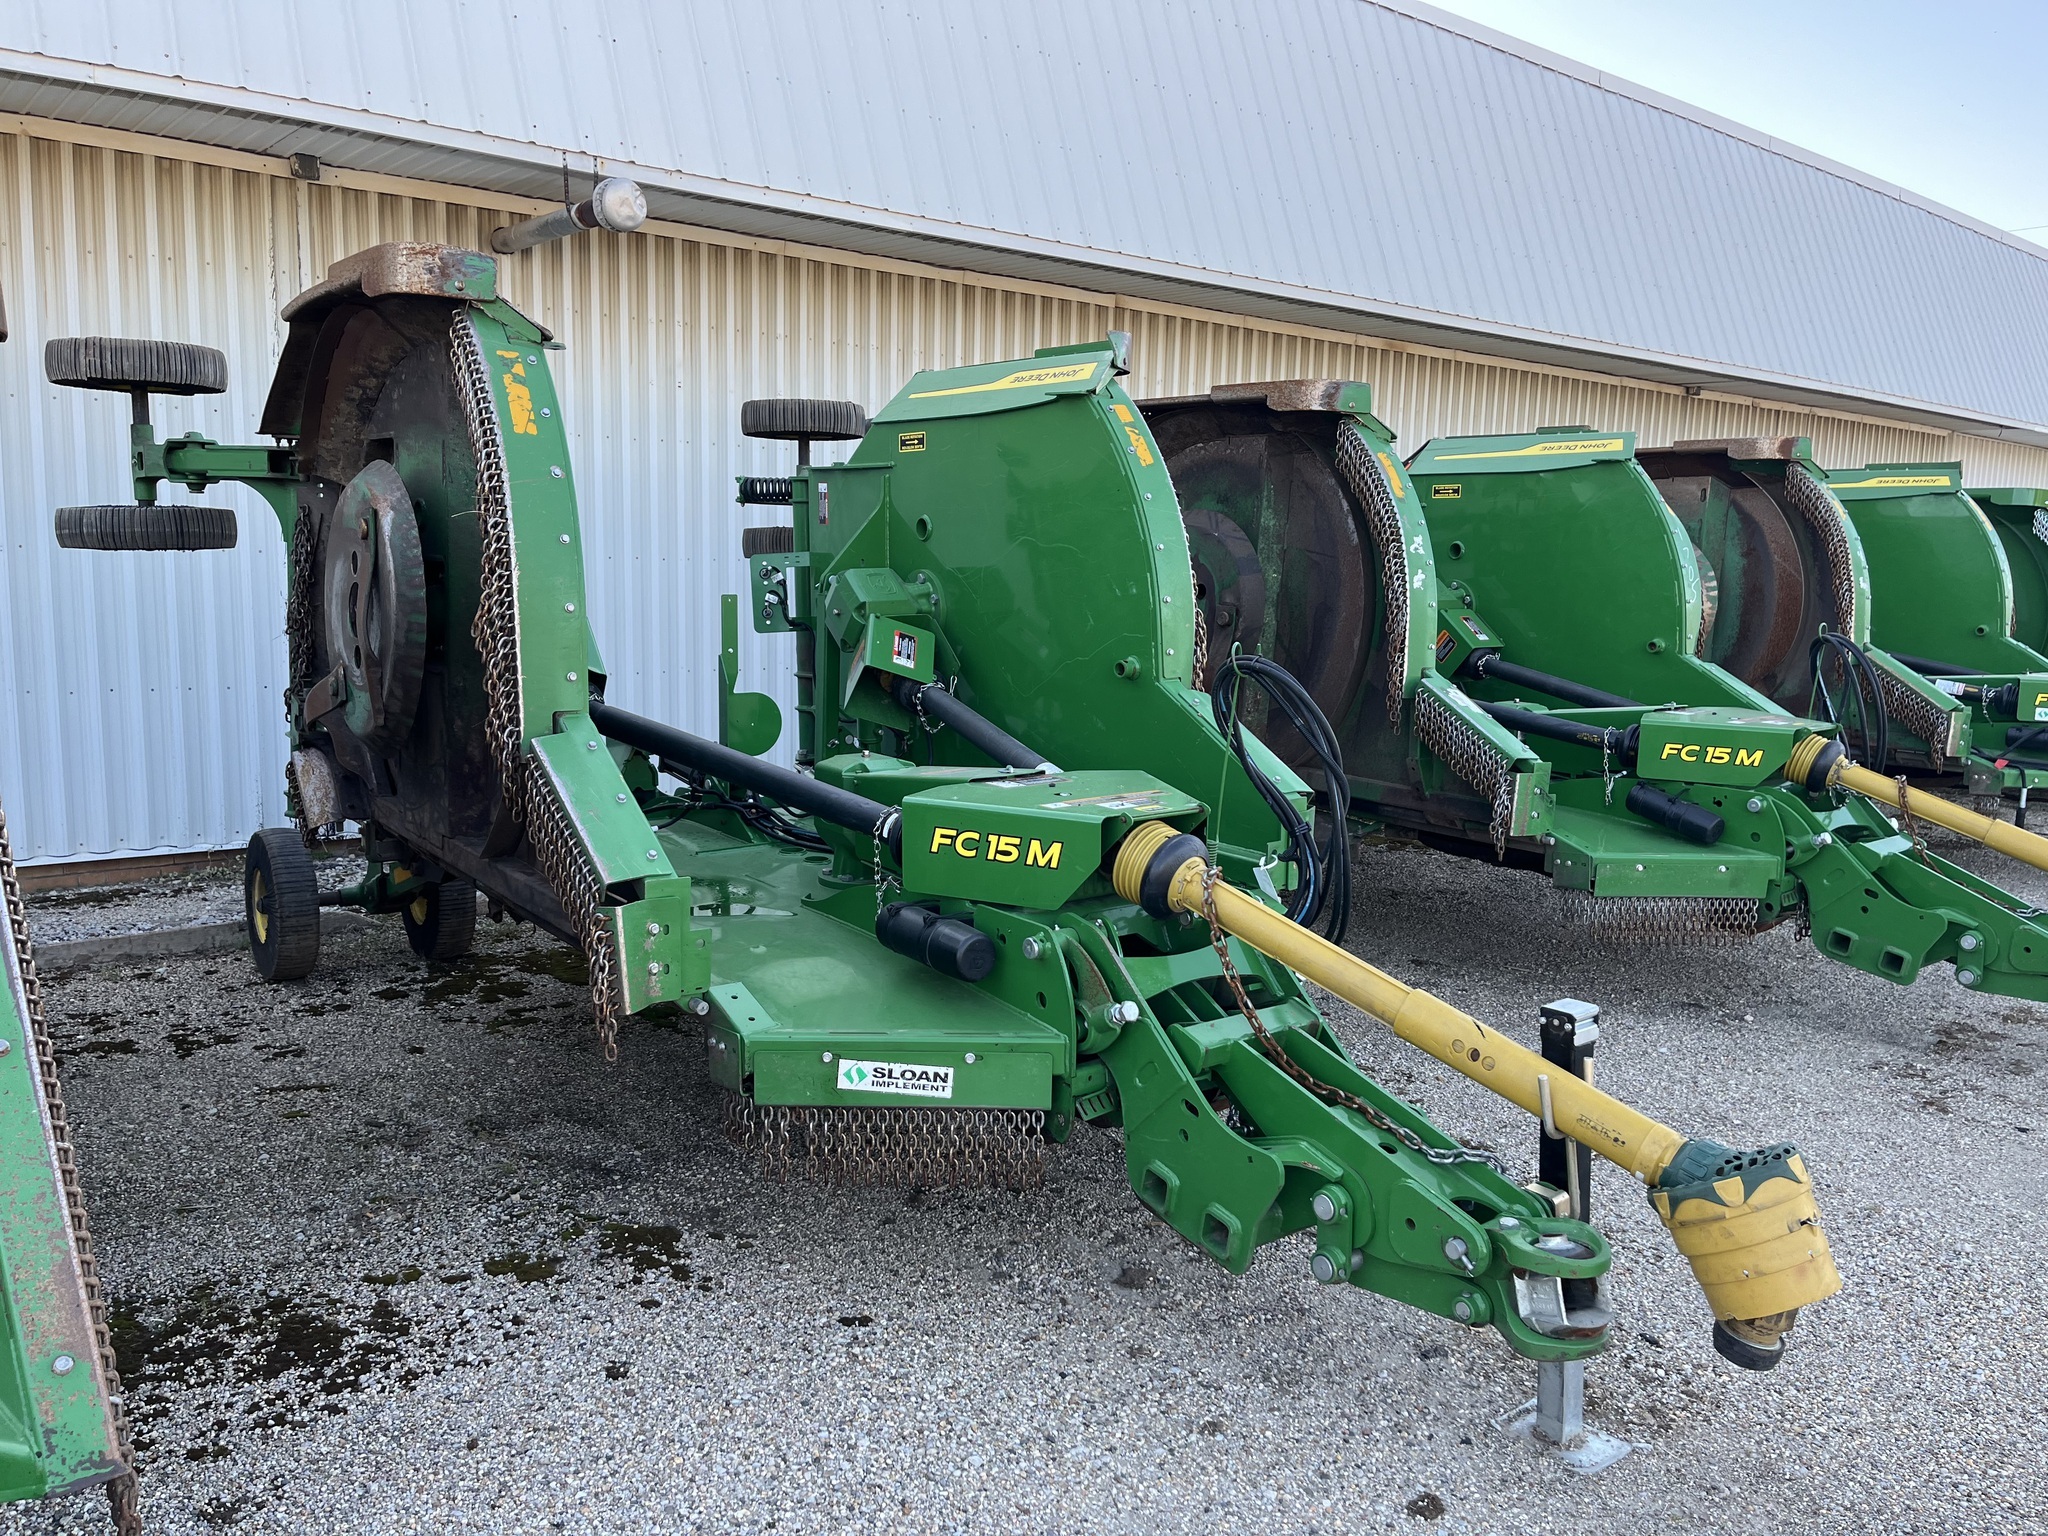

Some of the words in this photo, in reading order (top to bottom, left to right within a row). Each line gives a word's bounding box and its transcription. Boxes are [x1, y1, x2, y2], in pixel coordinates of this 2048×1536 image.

[1010, 373, 1048, 383] DEERE
[1049, 368, 1084, 379] JOHN
[1660, 742, 1701, 763] FC
[1703, 745, 1733, 765] 15
[1734, 747, 1765, 767] M
[929, 826, 981, 859] FC
[985, 833, 1022, 864] 15
[1024, 838, 1064, 870] M
[872, 1066, 949, 1084] SLOAN
[871, 1080, 948, 1092] IMPLEMENT
